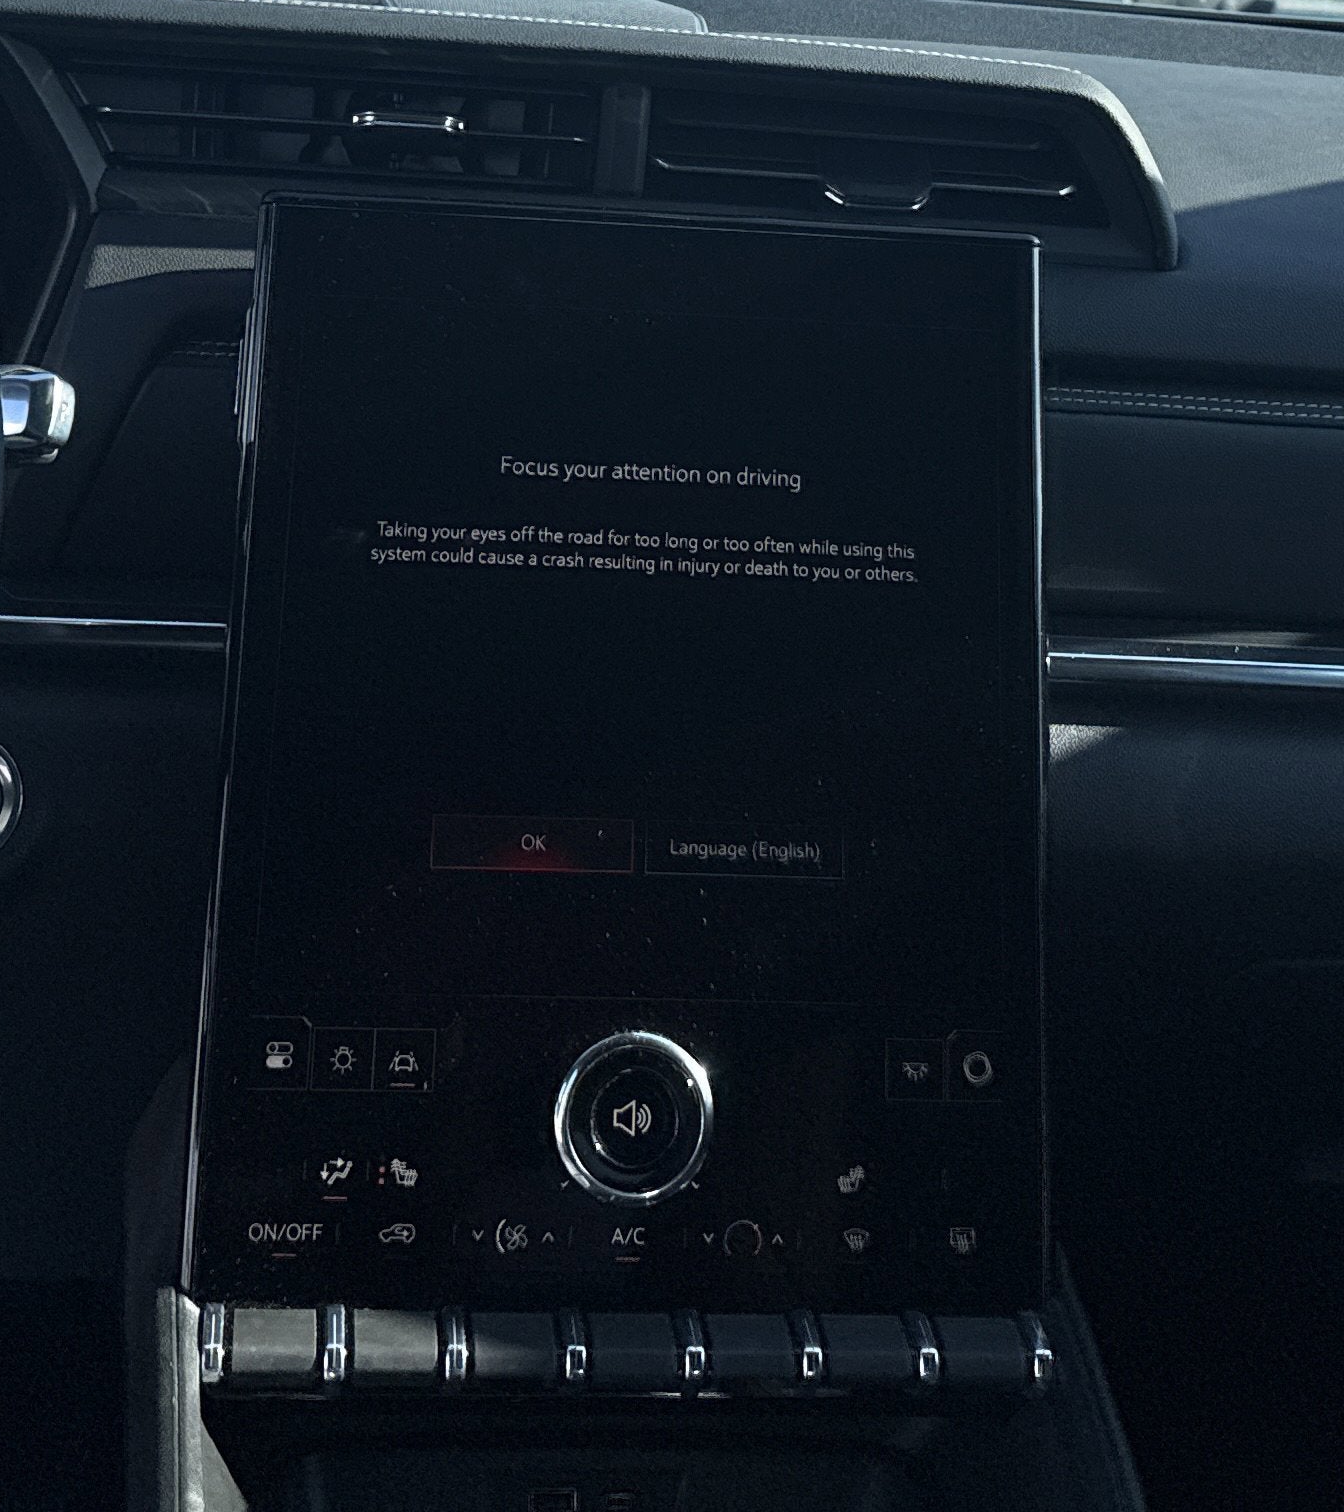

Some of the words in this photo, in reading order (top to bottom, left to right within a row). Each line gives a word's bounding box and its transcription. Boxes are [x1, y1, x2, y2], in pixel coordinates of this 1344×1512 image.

[500, 455, 559, 477] Focus
[562, 462, 607, 483] your
[611, 460, 701, 484] attention
[705, 469, 732, 486] on
[736, 465, 802, 493] driving
[377, 520, 428, 544] Taking
[430, 527, 467, 546] your
[469, 528, 507, 547] eyes
[510, 525, 536, 545] off
[537, 527, 564, 546] the
[567, 529, 605, 548] road
[606, 528, 631, 549] for
[634, 532, 661, 549] too
[664, 531, 699, 555] long
[702, 537, 720, 552] or
[723, 536, 750, 553] too
[753, 535, 796, 555] often
[798, 538, 840, 557] while
[842, 541, 884, 563] using
[886, 542, 916, 561] this
[370, 546, 427, 567] system
[430, 547, 474, 565] could
[478, 551, 525, 567] cause
[527, 553, 538, 567] a
[541, 551, 585, 570] crash
[588, 553, 656, 576] resulting
[659, 557, 674, 573] in
[677, 557, 721, 579] injury
[723, 562, 741, 576] or
[744, 558, 789, 577] death
[792, 563, 809, 578] to
[811, 566, 841, 584] you
[843, 567, 861, 581] or
[864, 565, 919, 584] others.
[521, 833, 547, 852] OK
[669, 839, 747, 862] Language
[752, 840, 821, 863] (English)
[248, 1222, 324, 1243] ON/OFF
[611, 1226, 646, 1248] A/C
